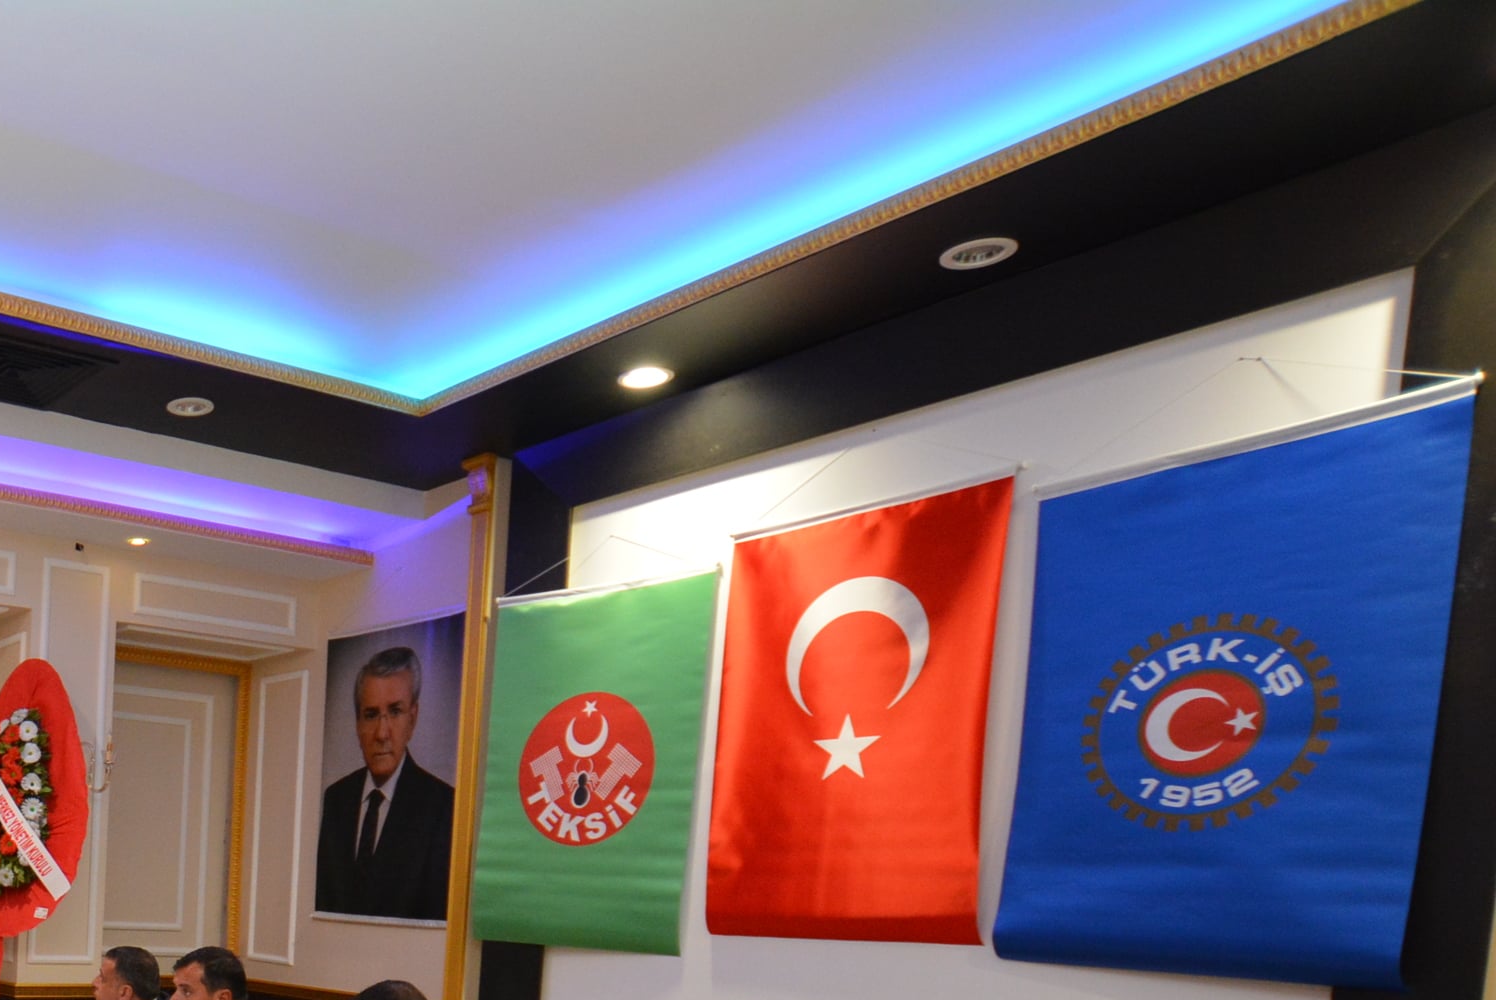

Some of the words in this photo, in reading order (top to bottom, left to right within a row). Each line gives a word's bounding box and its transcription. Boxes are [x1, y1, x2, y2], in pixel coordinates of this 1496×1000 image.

[1107, 637, 1304, 714] TÜRK-İŞ
[1139, 767, 1260, 809] 1952
[26, 847, 53, 877] KURULU
